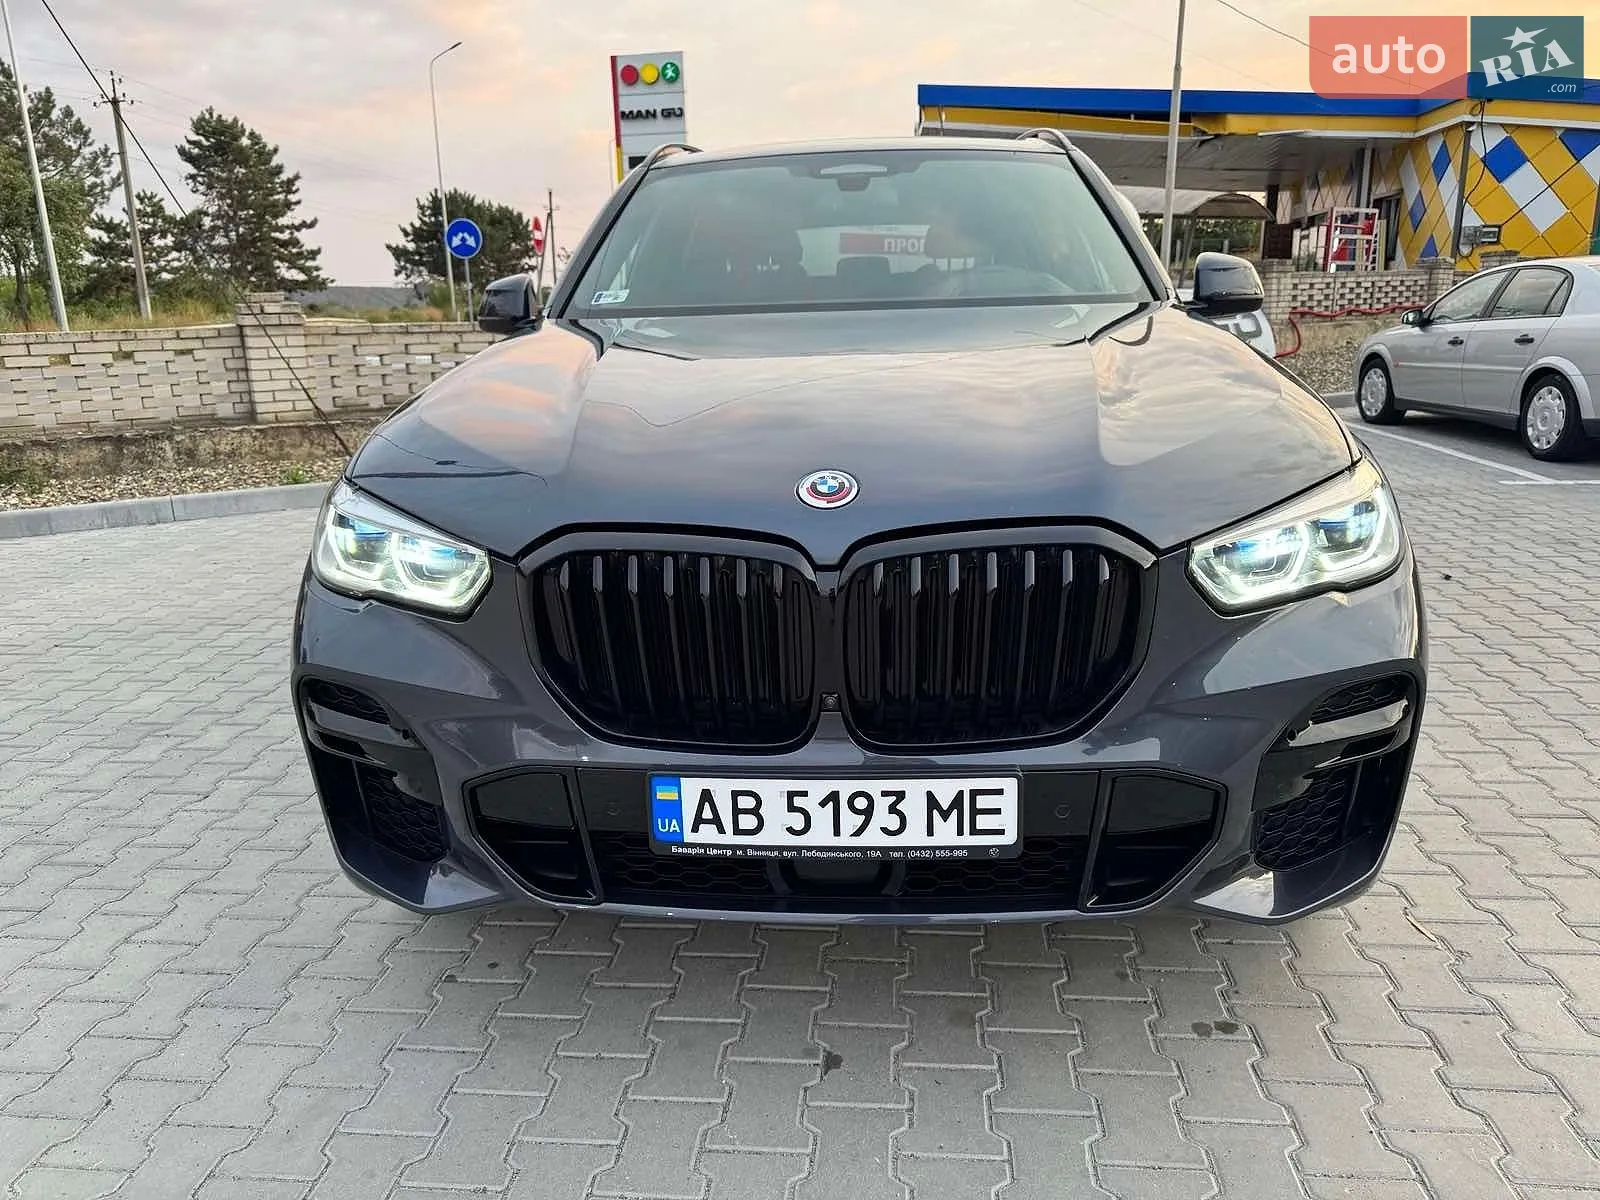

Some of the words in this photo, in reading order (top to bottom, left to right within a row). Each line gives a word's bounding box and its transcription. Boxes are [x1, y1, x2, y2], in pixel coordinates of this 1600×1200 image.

[690, 788, 765, 837] AB
[785, 790, 907, 838] 5193
[926, 788, 1006, 837] ME
[657, 818, 681, 833] UA
[736, 849, 745, 857] м.
[782, 850, 800, 859] вул.
[888, 850, 906, 859] тел.
[907, 849, 934, 860] (0432)
[935, 849, 968, 858] 555-995
